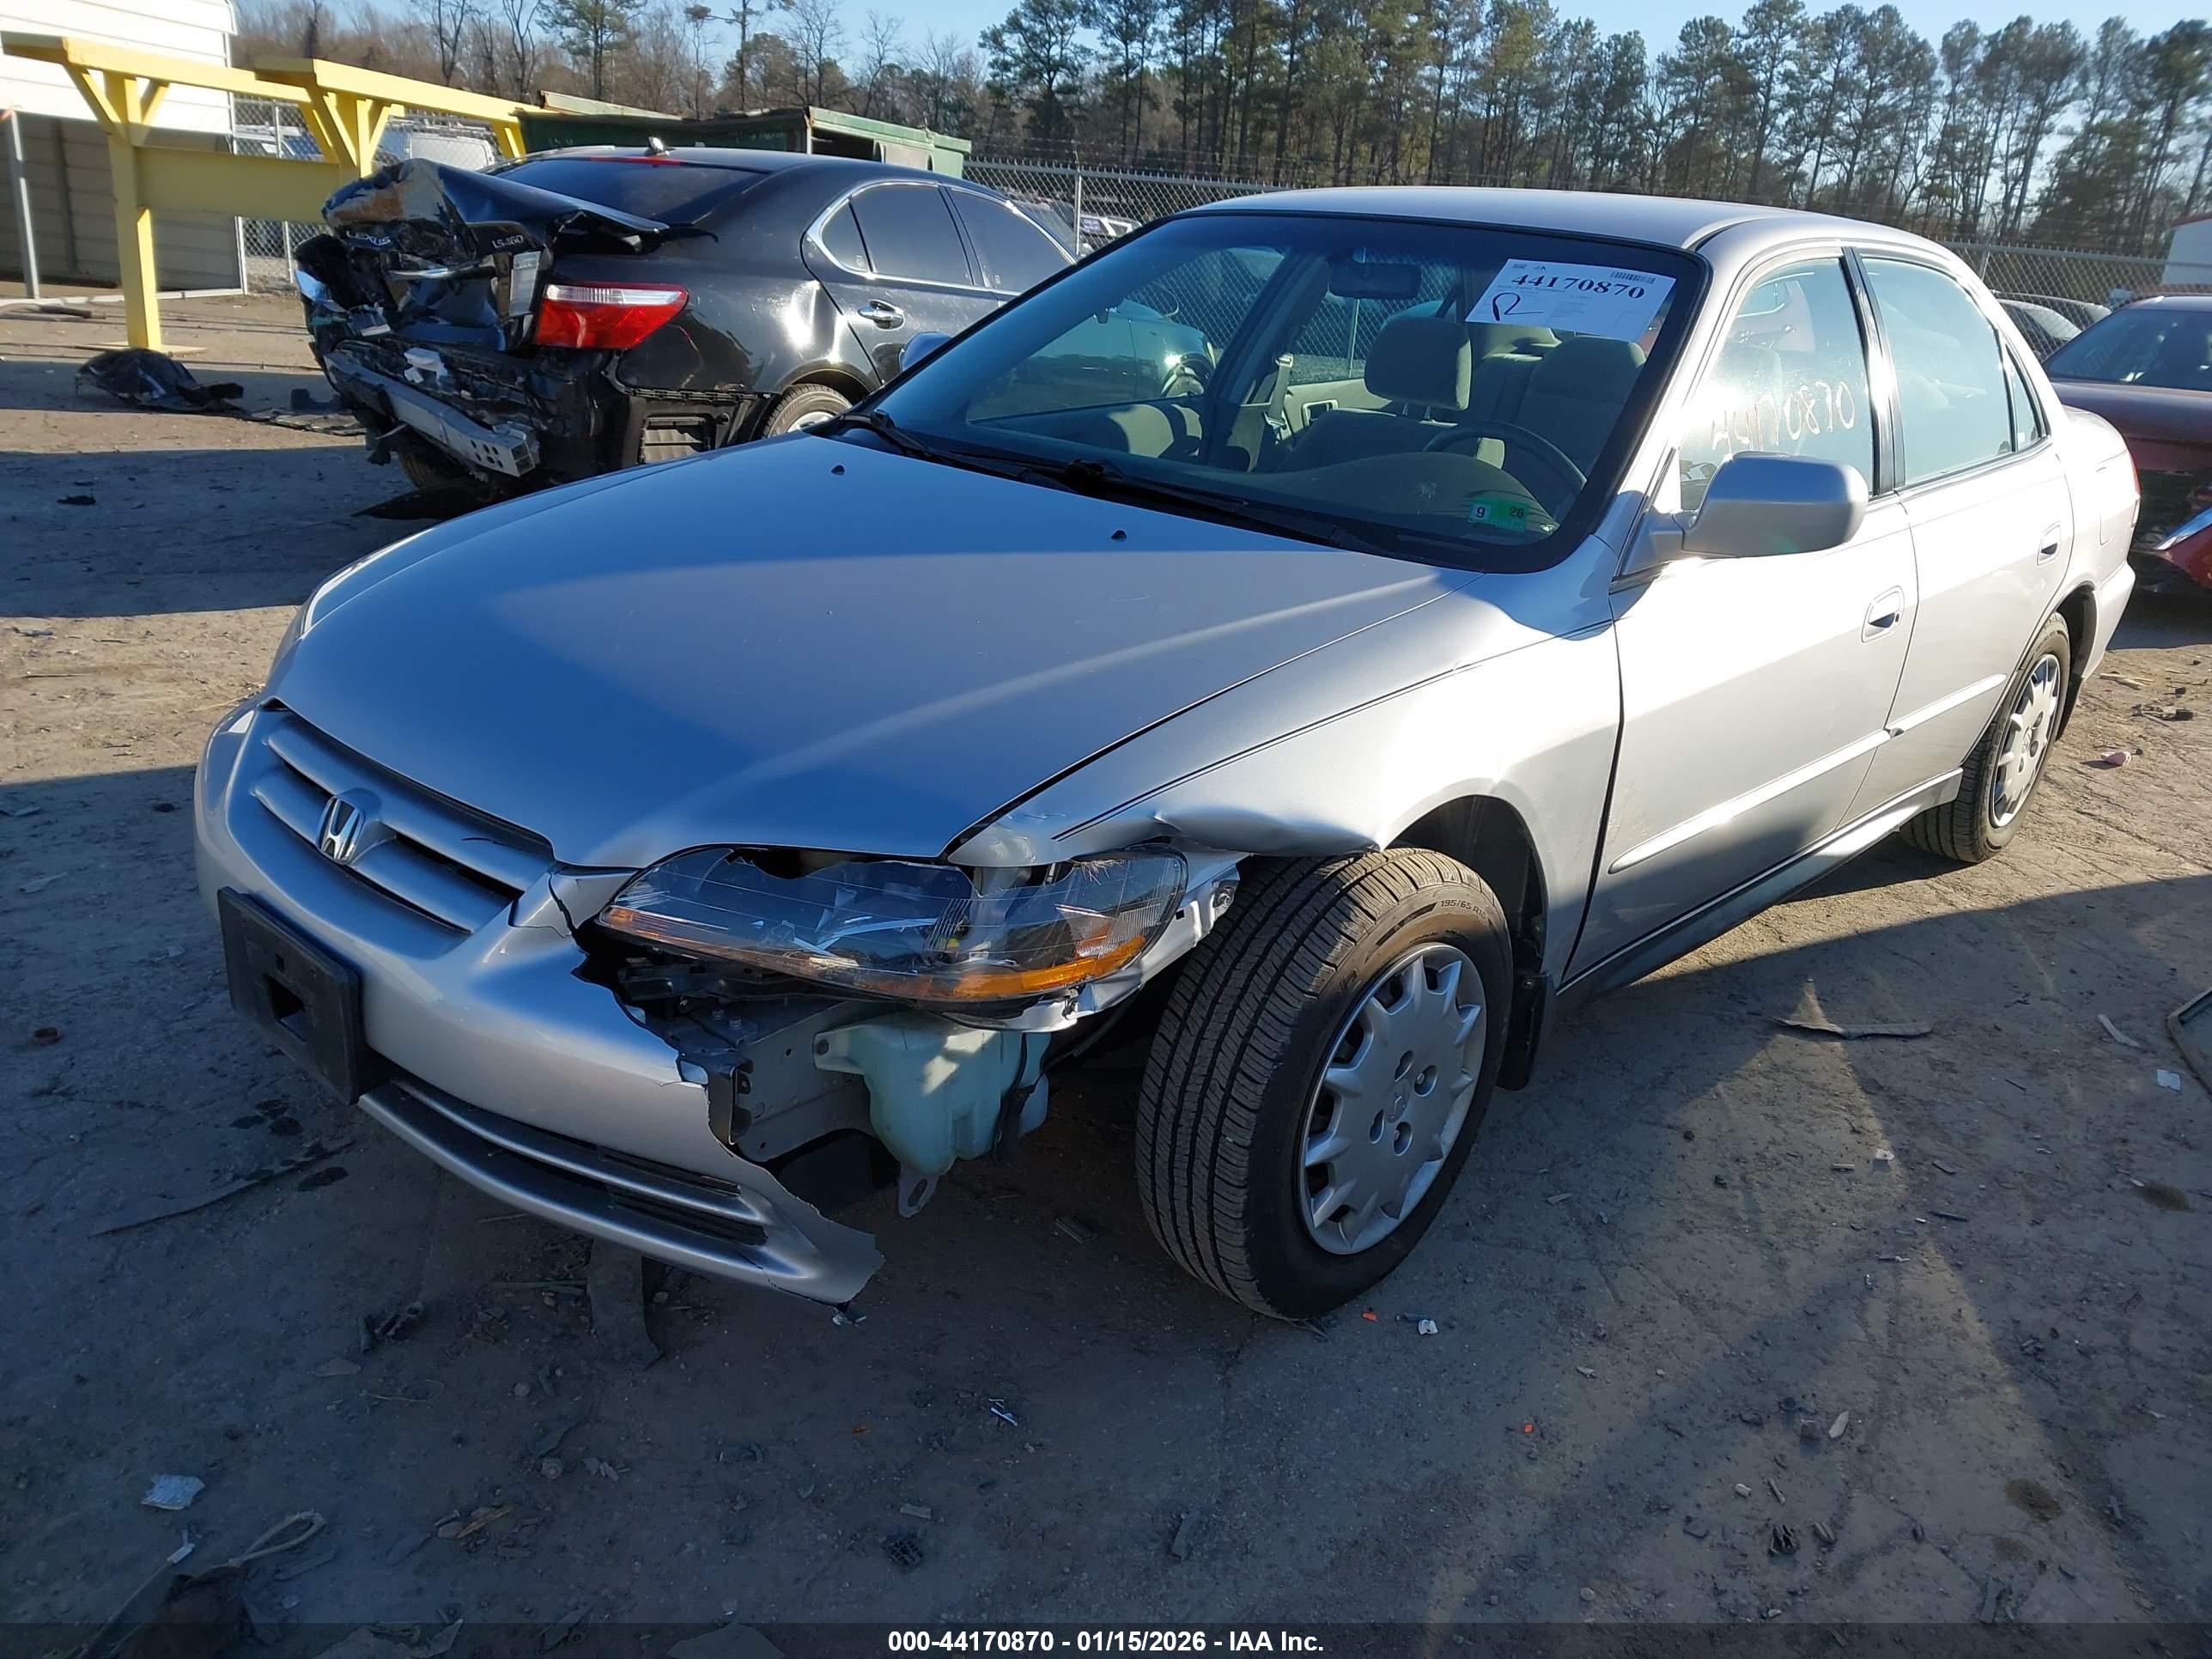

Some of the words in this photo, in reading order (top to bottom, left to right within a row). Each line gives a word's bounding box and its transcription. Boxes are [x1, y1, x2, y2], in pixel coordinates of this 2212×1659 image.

[346, 230, 392, 246] LEXUS
[1510, 274, 1646, 300] 44170870
[1476, 507, 1486, 519] 9
[1509, 507, 1525, 519] 26
[1440, 899, 1473, 910] 195/65
